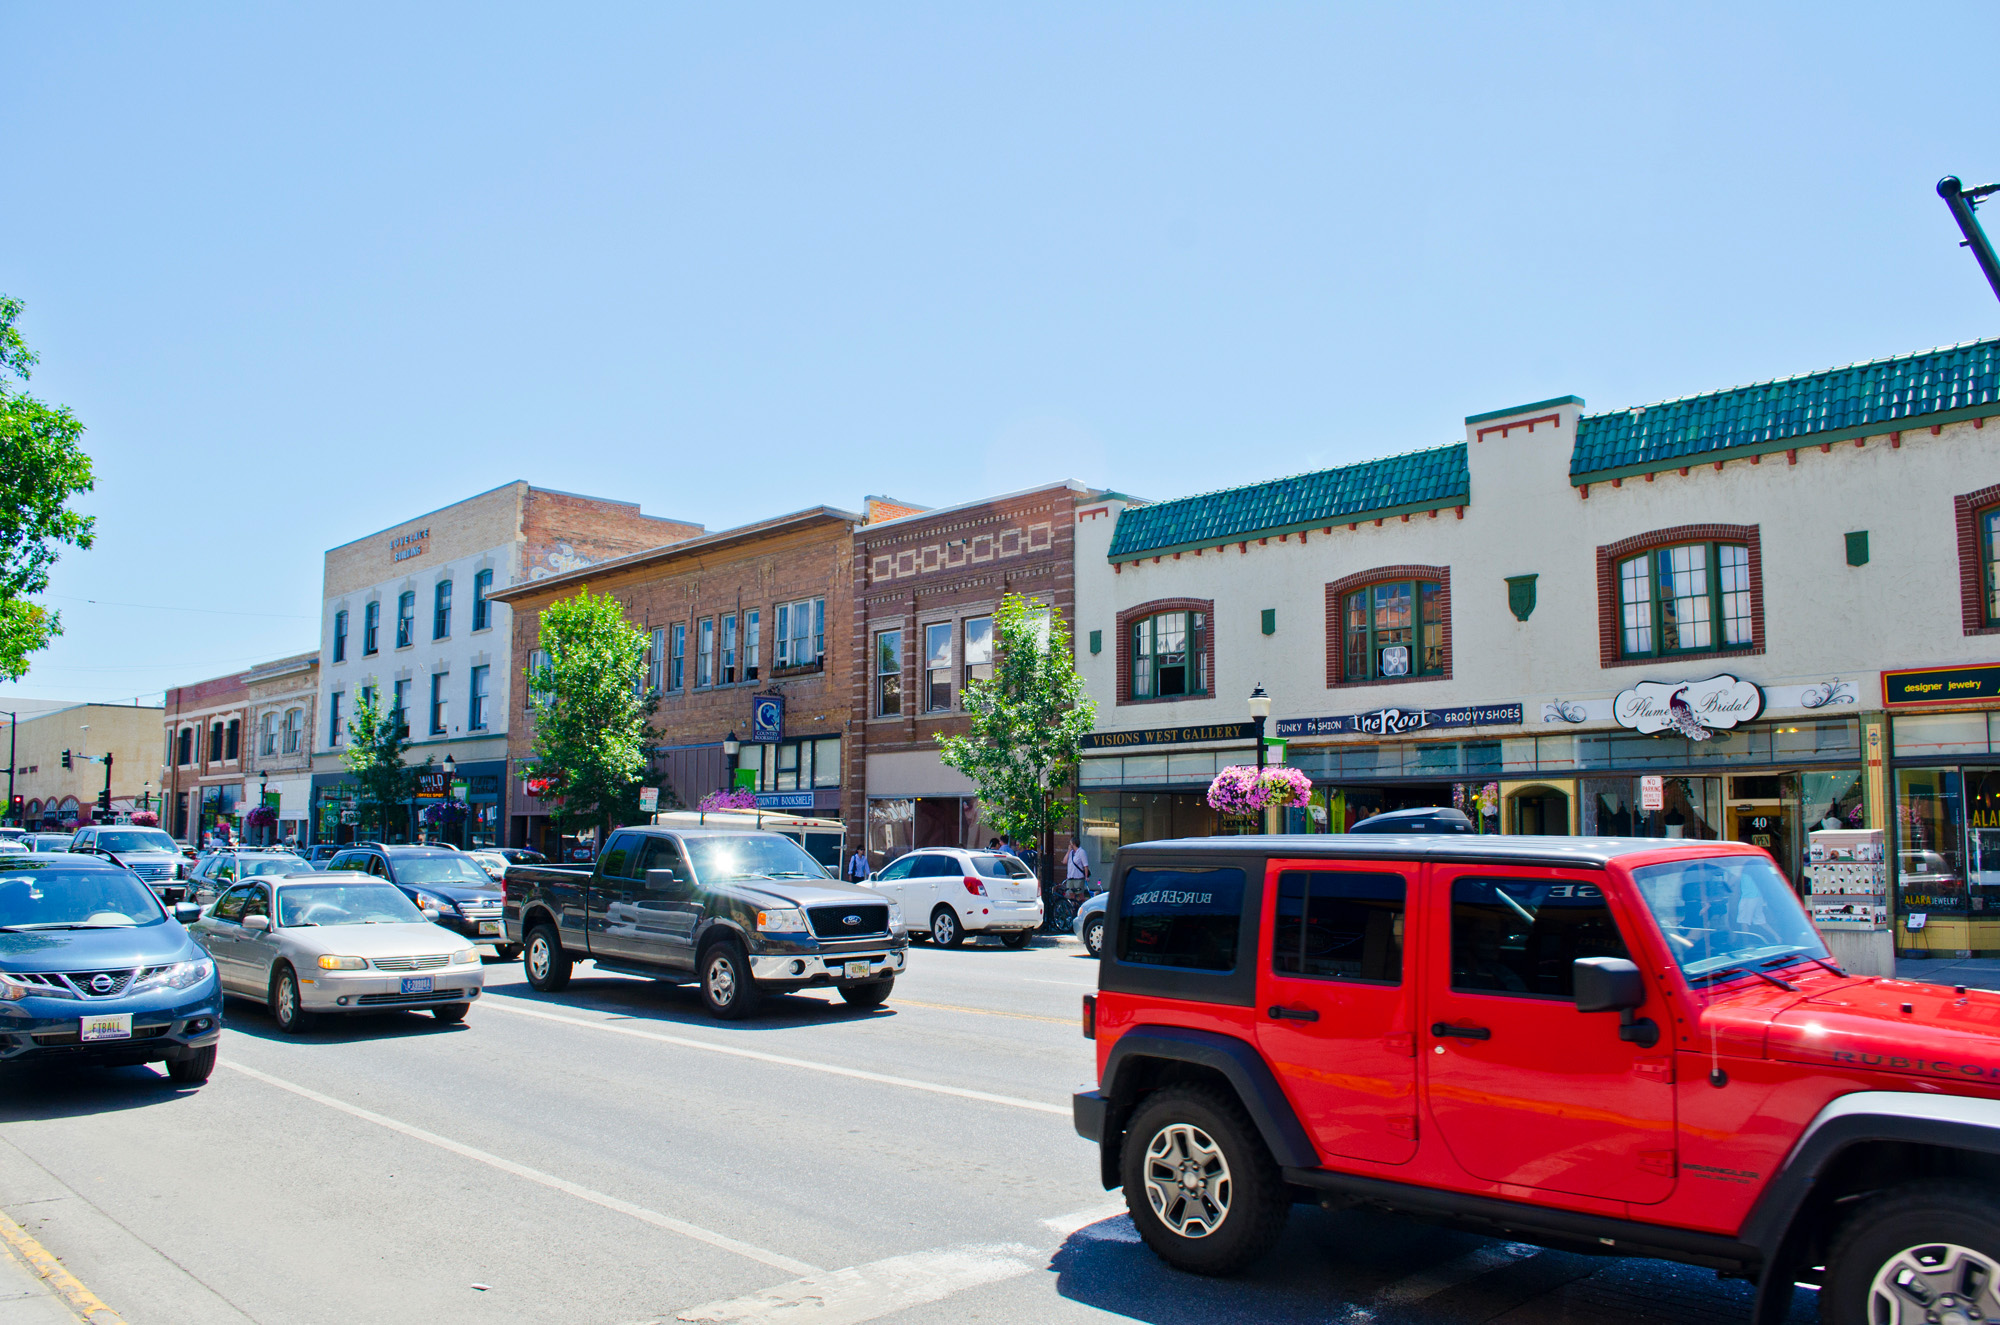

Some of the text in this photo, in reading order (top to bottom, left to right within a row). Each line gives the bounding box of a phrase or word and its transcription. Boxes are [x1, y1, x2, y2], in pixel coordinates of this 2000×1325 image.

[389, 528, 430, 550] LOVELACE
[395, 545, 422, 562] BUILDING
[1904, 683, 1943, 693] designer
[1948, 680, 1982, 691] jewelry
[1622, 689, 1756, 718] Plume Bridal
[1276, 722, 1303, 734] FUNKY
[1307, 720, 1342, 731] FASHION
[1444, 710, 1485, 723] GROOVY
[1485, 707, 1521, 720] SHOES
[1094, 725, 1242, 746] VISIONS WEST GALLERY
[418, 774, 444, 791] WILD
[1642, 785, 1662, 793] PARKING
[756, 794, 813, 806] COUNTRY BOOKSHELF
[326, 815, 338, 824] 90
[1752, 817, 1767, 828] 40
[1753, 836, 1769, 846] OPEN
[1904, 895, 1958, 905] ALARA JEWELRY
[92, 1022, 120, 1034] FTBALL
